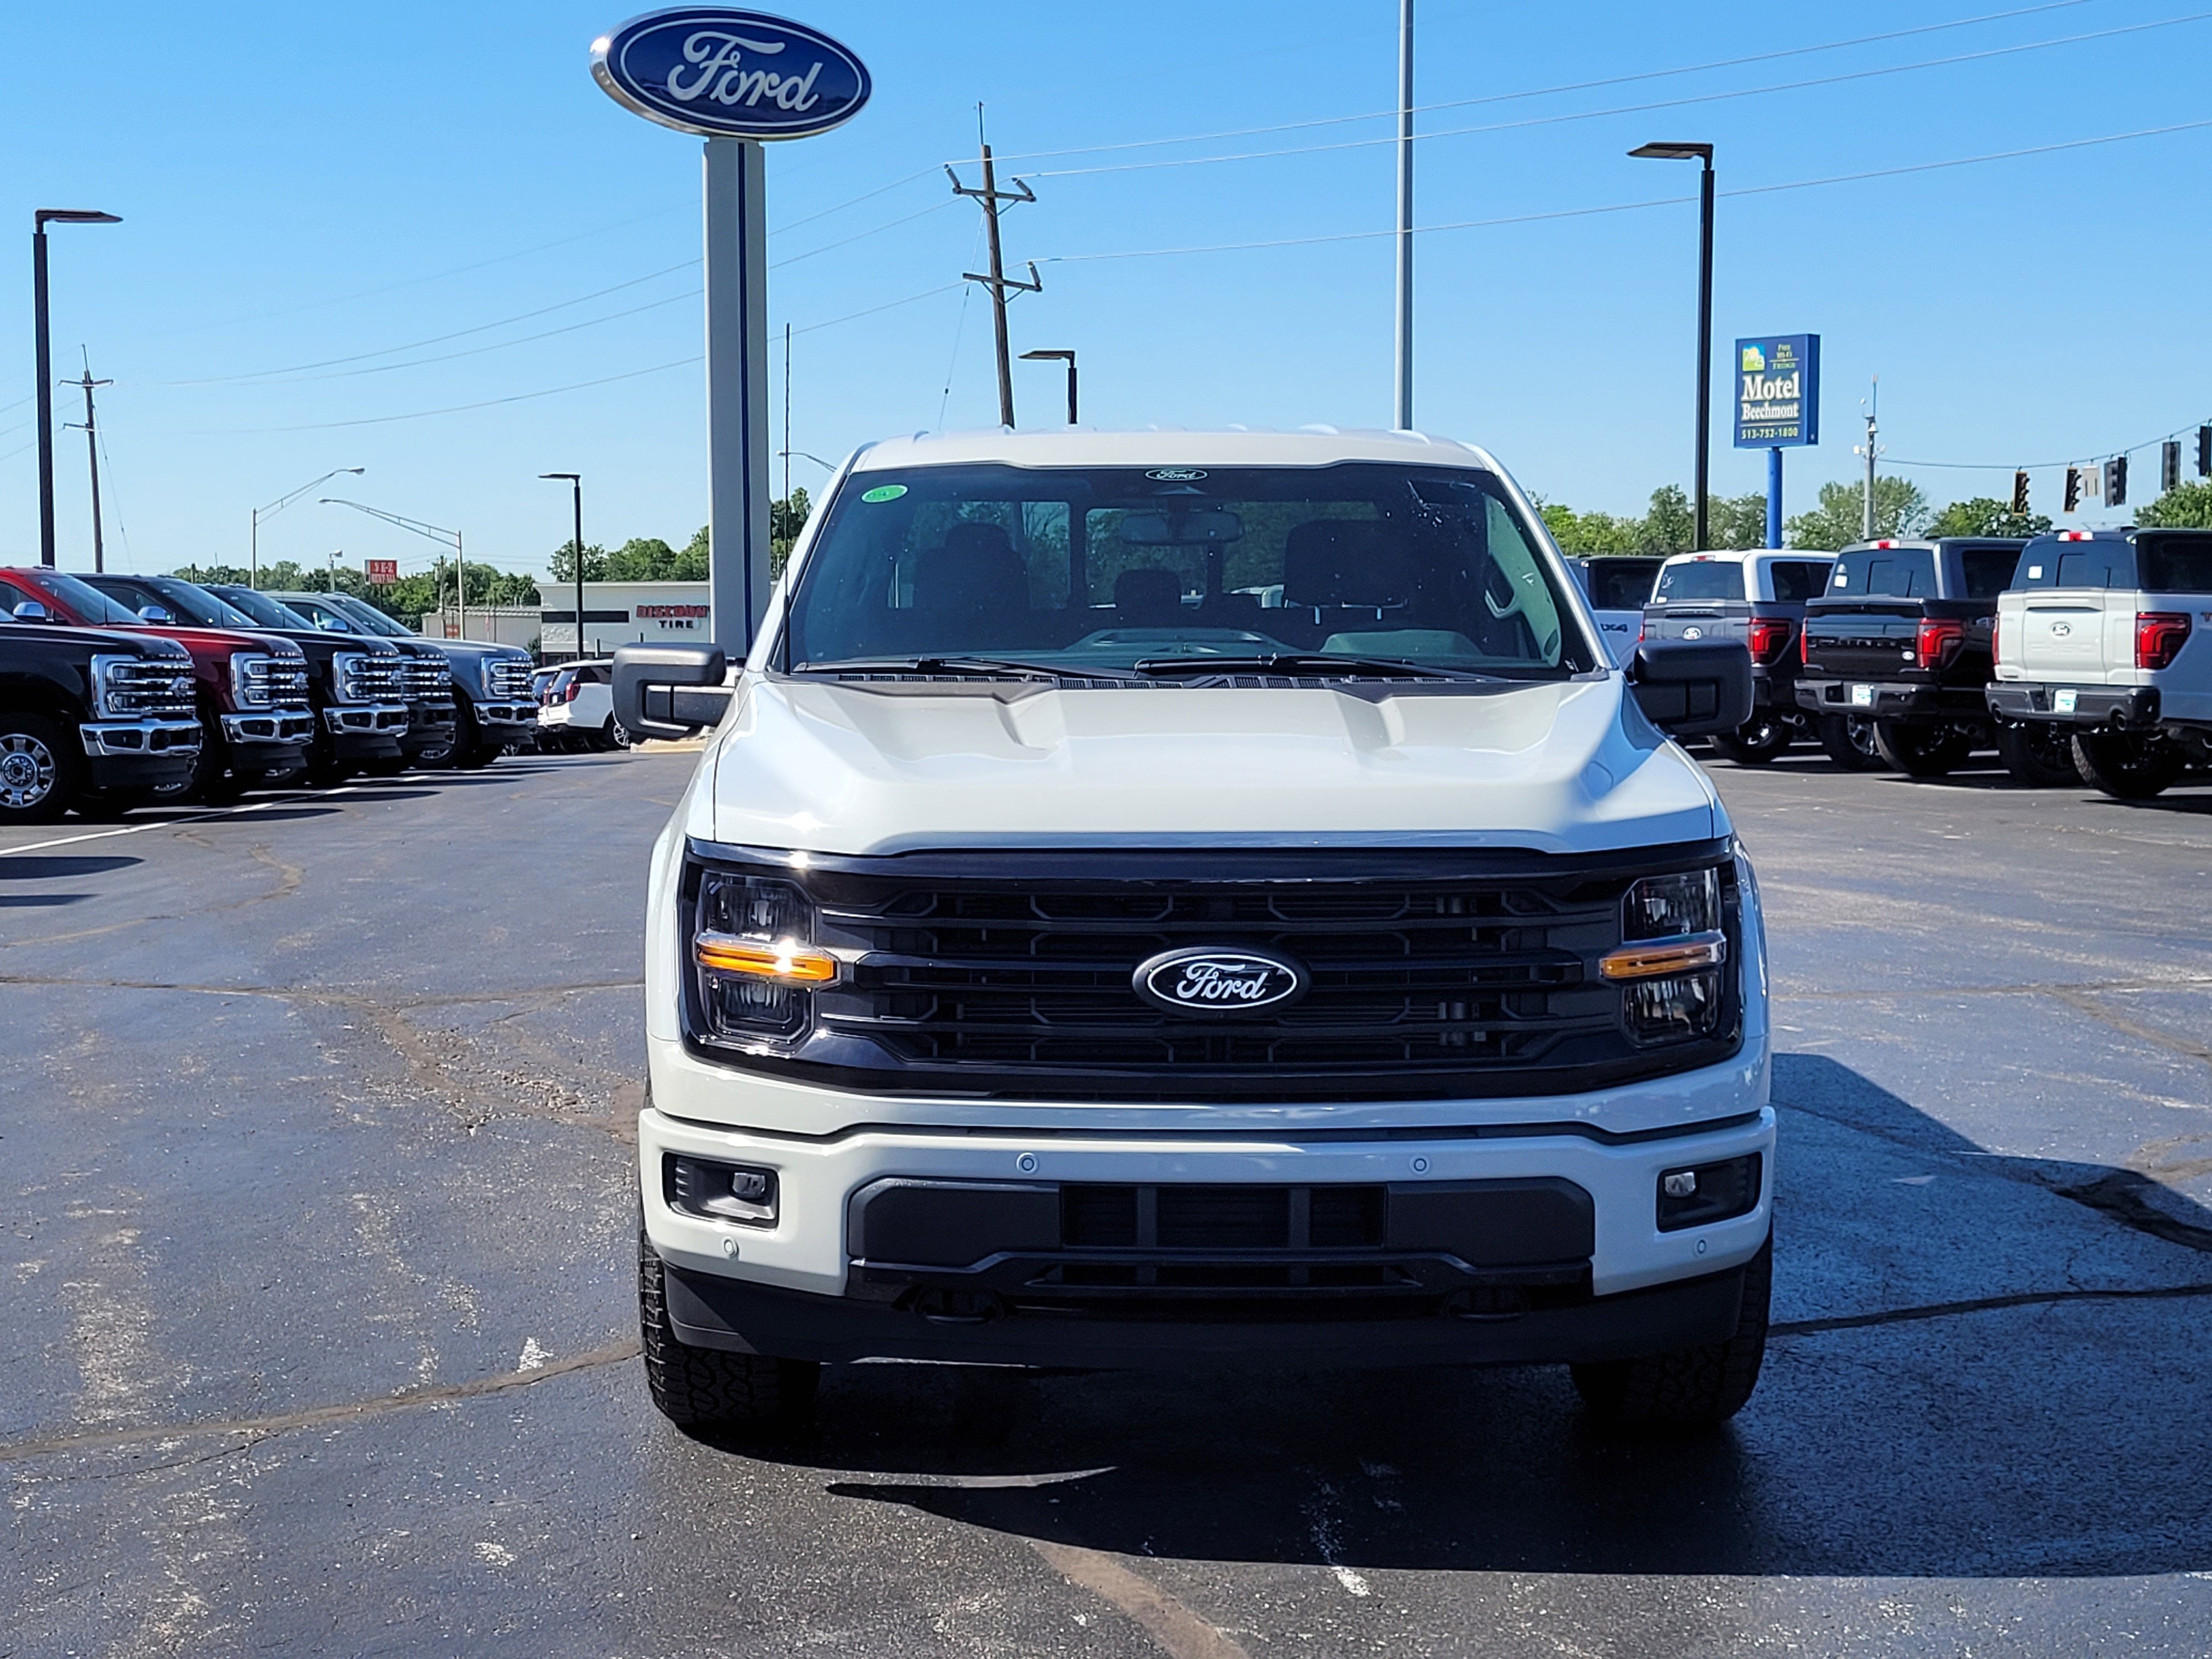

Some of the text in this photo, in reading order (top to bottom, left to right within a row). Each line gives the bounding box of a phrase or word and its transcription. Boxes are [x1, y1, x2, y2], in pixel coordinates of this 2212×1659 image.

[667, 31, 823, 111] Ford
[1741, 371, 1801, 401] Motel
[1741, 402, 1799, 421] Beechmont
[1156, 469, 1197, 479] Ford
[636, 605, 710, 618] DISCOUN
[658, 620, 693, 629] TIRE
[1177, 962, 1268, 999] Ford
